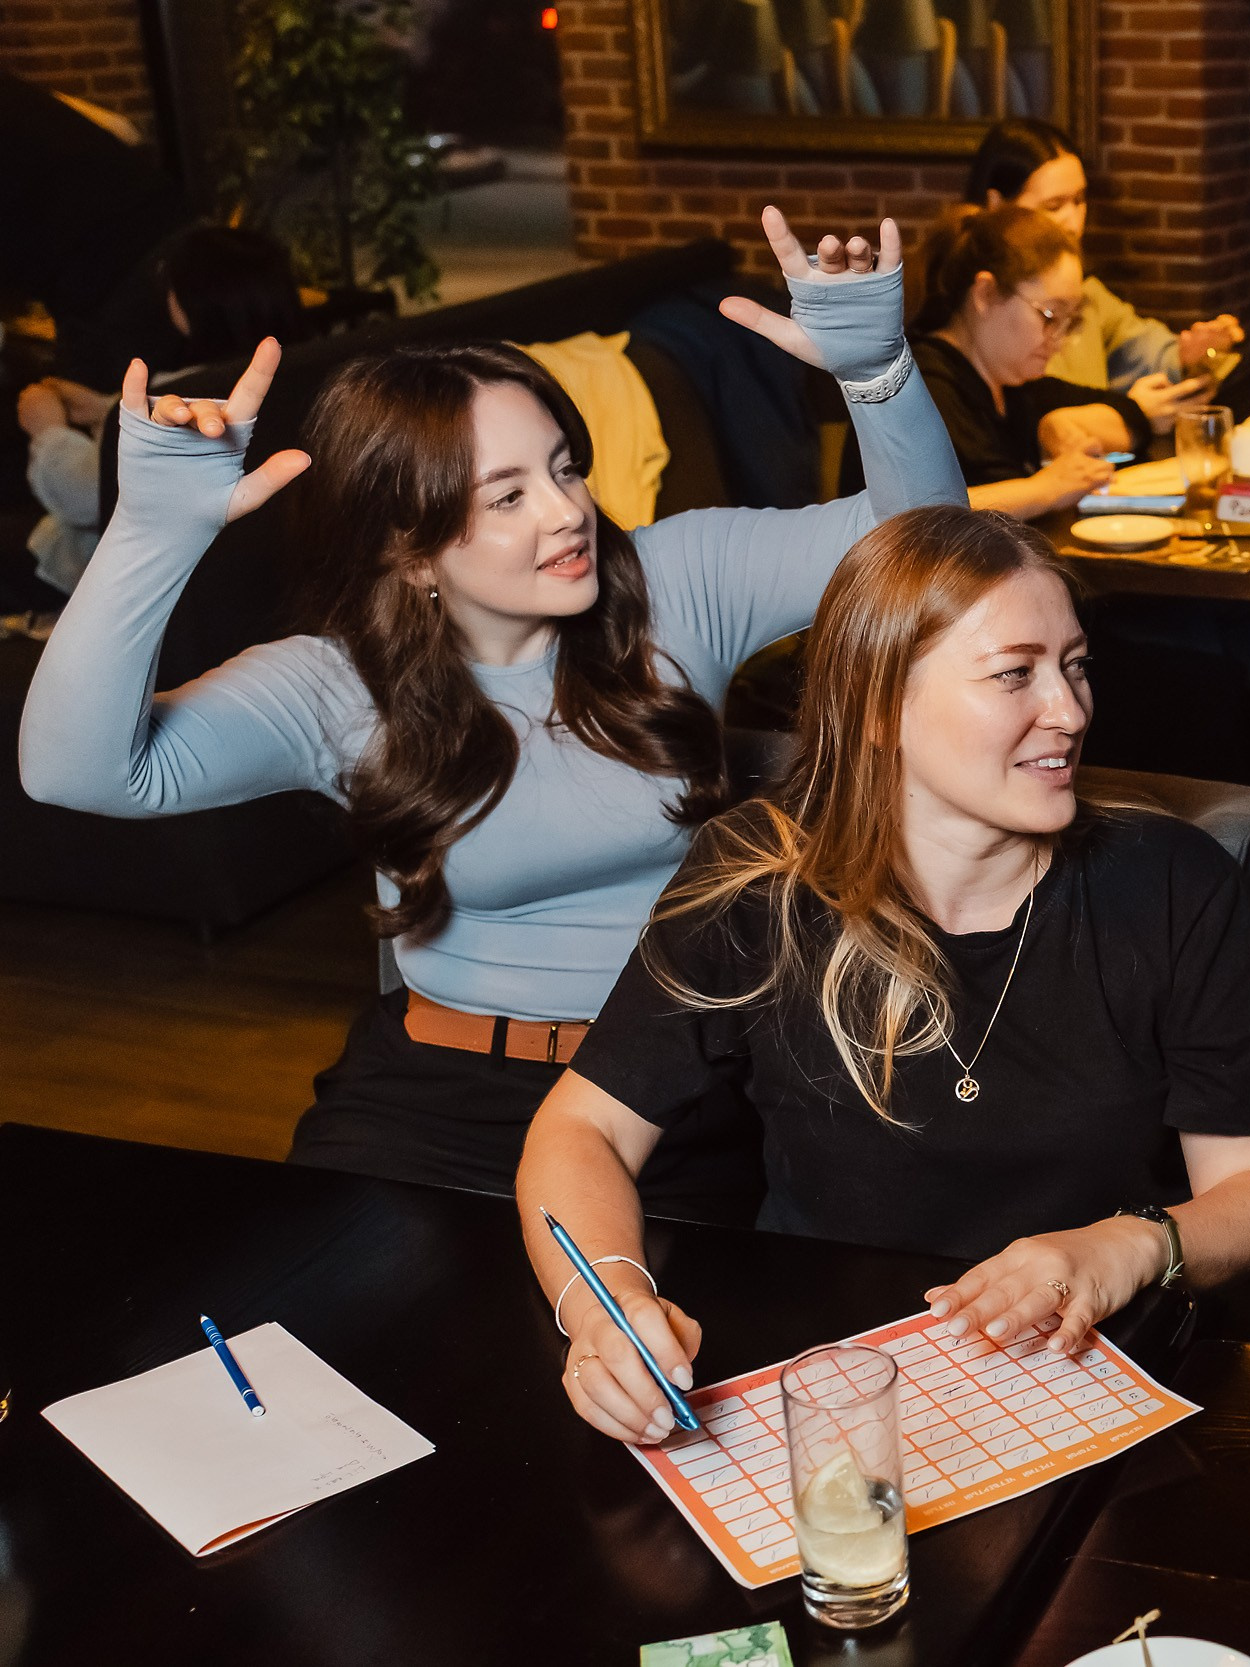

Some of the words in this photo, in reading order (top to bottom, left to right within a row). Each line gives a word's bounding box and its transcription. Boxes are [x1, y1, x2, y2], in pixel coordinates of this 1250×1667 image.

[1108, 1424, 1145, 1443] ПЕРВЫЙ
[1064, 1443, 1098, 1461] ВТОРОЙ
[1022, 1460, 1057, 1479] ТРЕТИЙ
[963, 1475, 1016, 1502] ЧЕТВЕРТЫЙ
